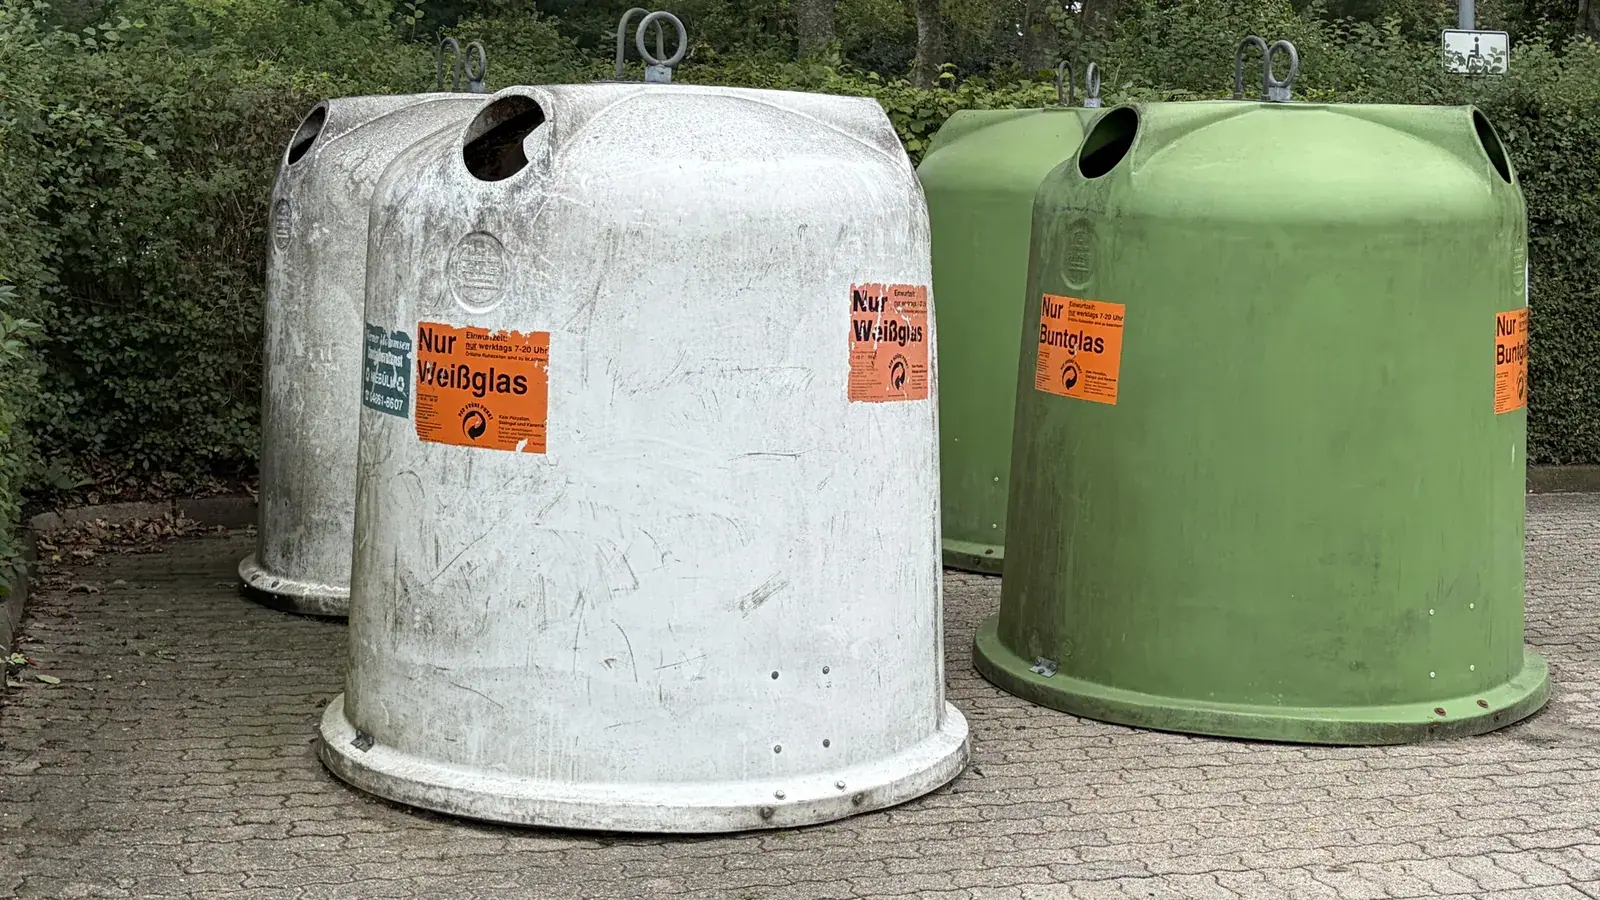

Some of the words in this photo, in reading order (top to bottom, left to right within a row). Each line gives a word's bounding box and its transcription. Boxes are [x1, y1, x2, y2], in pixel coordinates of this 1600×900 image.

[853, 290, 888, 312] Nur
[1042, 297, 1063, 319] Nur
[1077, 311, 1098, 319] werktags
[1497, 316, 1516, 336] Nur
[419, 327, 456, 354] Nur
[853, 320, 922, 346] Weißglas
[1040, 324, 1104, 355] Buntglas
[479, 344, 512, 353] werktags
[515, 345, 531, 353] 7-20
[534, 346, 548, 354] Uhr
[417, 359, 528, 398] Weißglas
